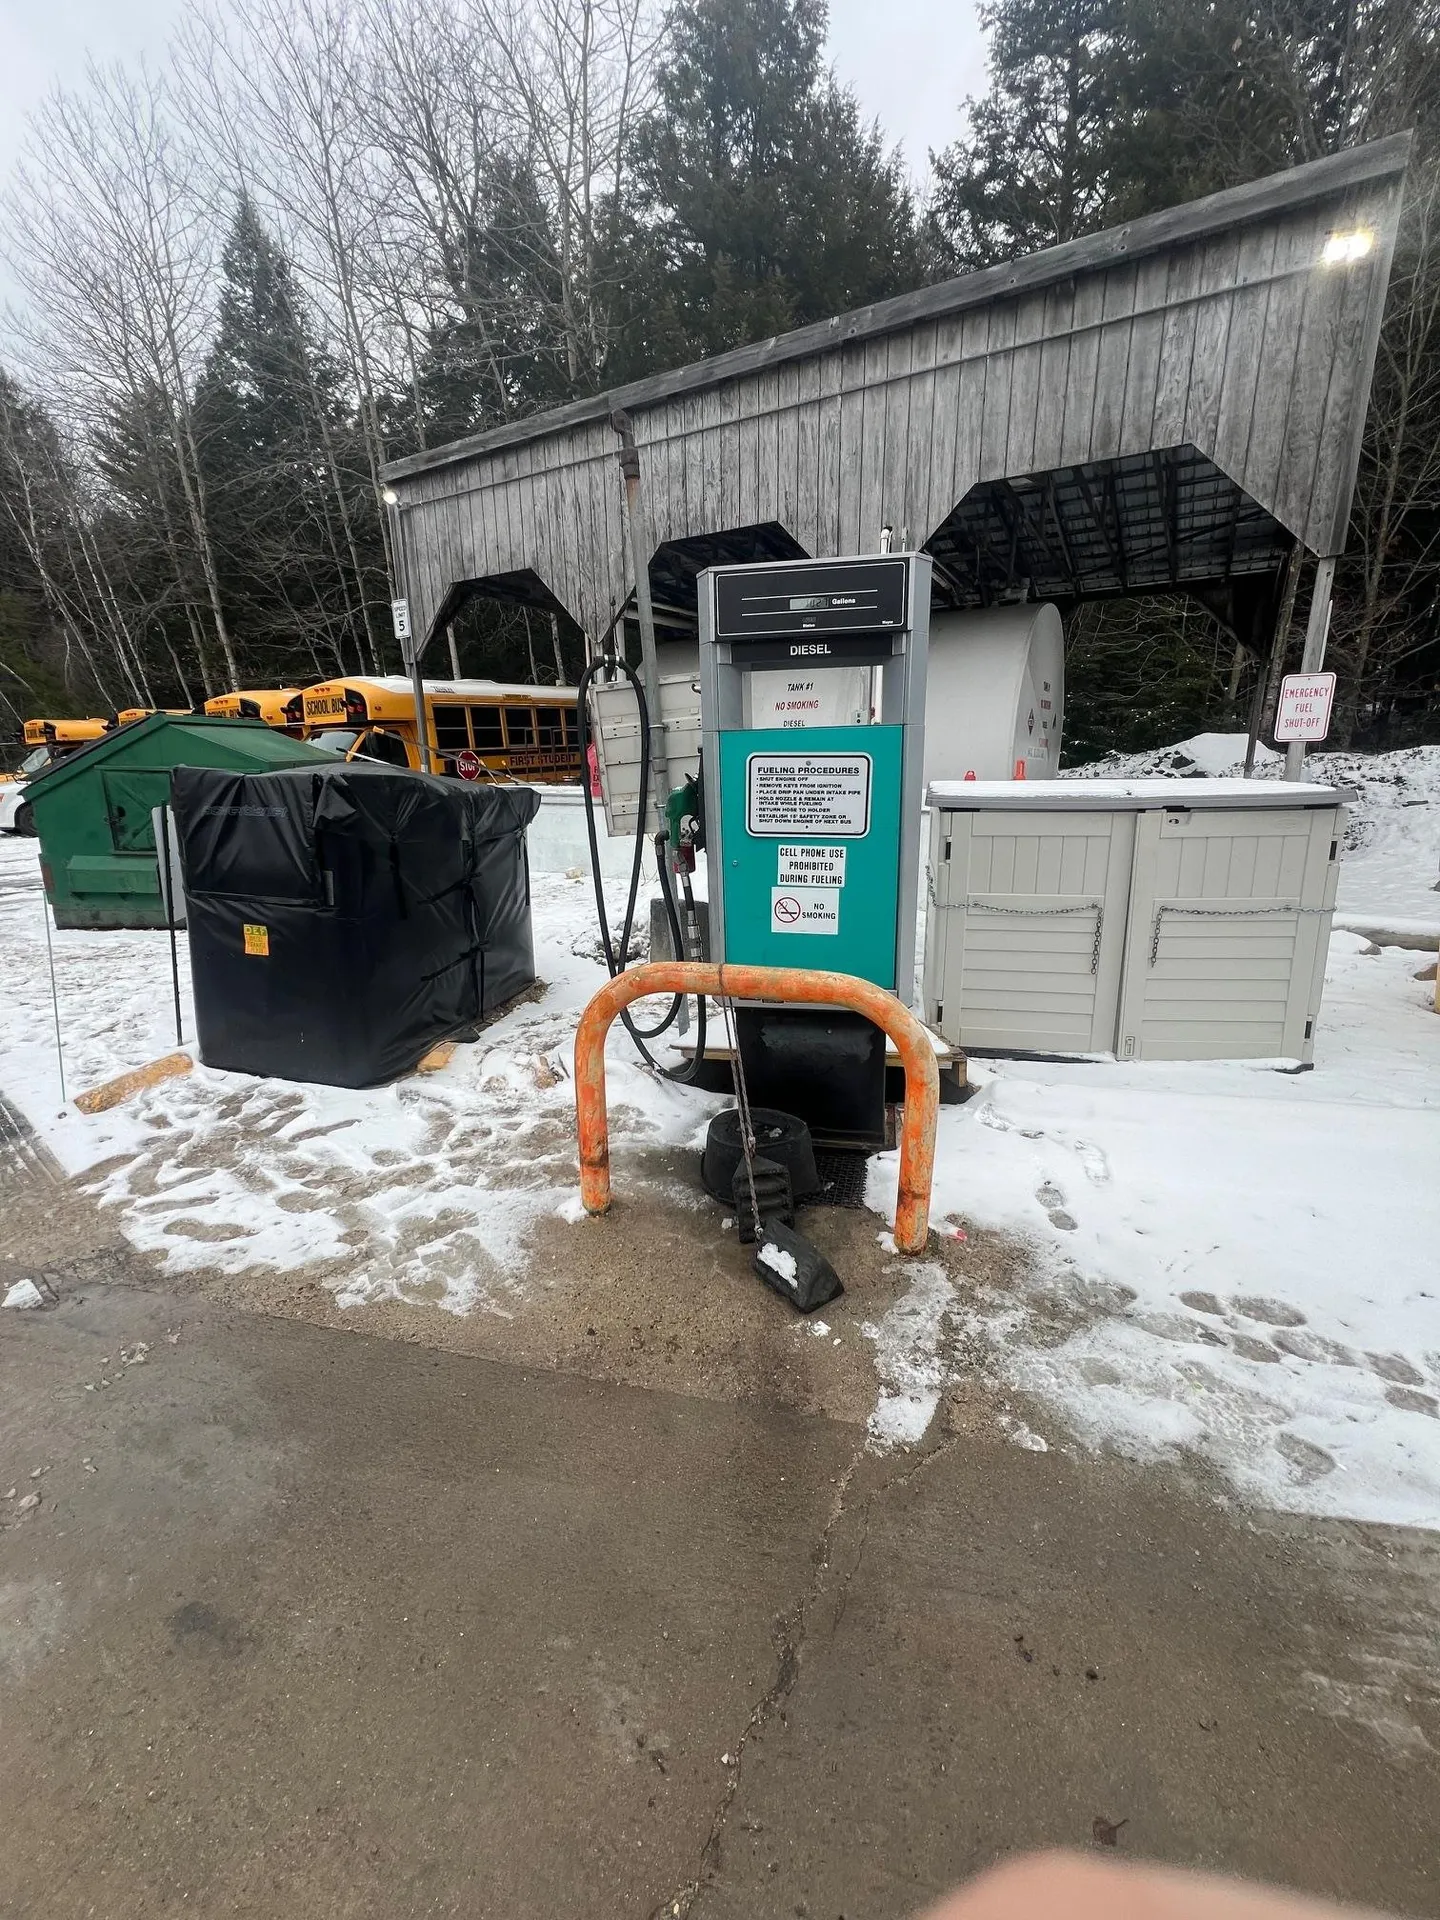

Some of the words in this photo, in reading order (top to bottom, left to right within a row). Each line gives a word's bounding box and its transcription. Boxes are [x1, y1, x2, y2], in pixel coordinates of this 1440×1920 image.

[399, 620, 406, 632] 5
[790, 644, 831, 656] DIESEL
[787, 684, 804, 692] TANK
[806, 683, 814, 691] #1
[1285, 687, 1329, 699] EMERGENCY
[307, 697, 330, 715] SCHOOL
[775, 702, 786, 711] NO
[786, 700, 819, 710] SMOKING
[1295, 703, 1312, 712] FUEL
[783, 720, 806, 728] DIESEL
[1284, 717, 1320, 728] SHUT-OFF
[510, 755, 534, 766] FIRST
[538, 754, 577, 764] STUDENT
[460, 760, 476, 772] STOP
[780, 848, 797, 856] CELL
[801, 848, 825, 857] PHONE
[829, 849, 844, 858] USE
[789, 862, 834, 871] PROHIBITED
[780, 874, 808, 883] DURING
[811, 875, 842, 884] FUELING
